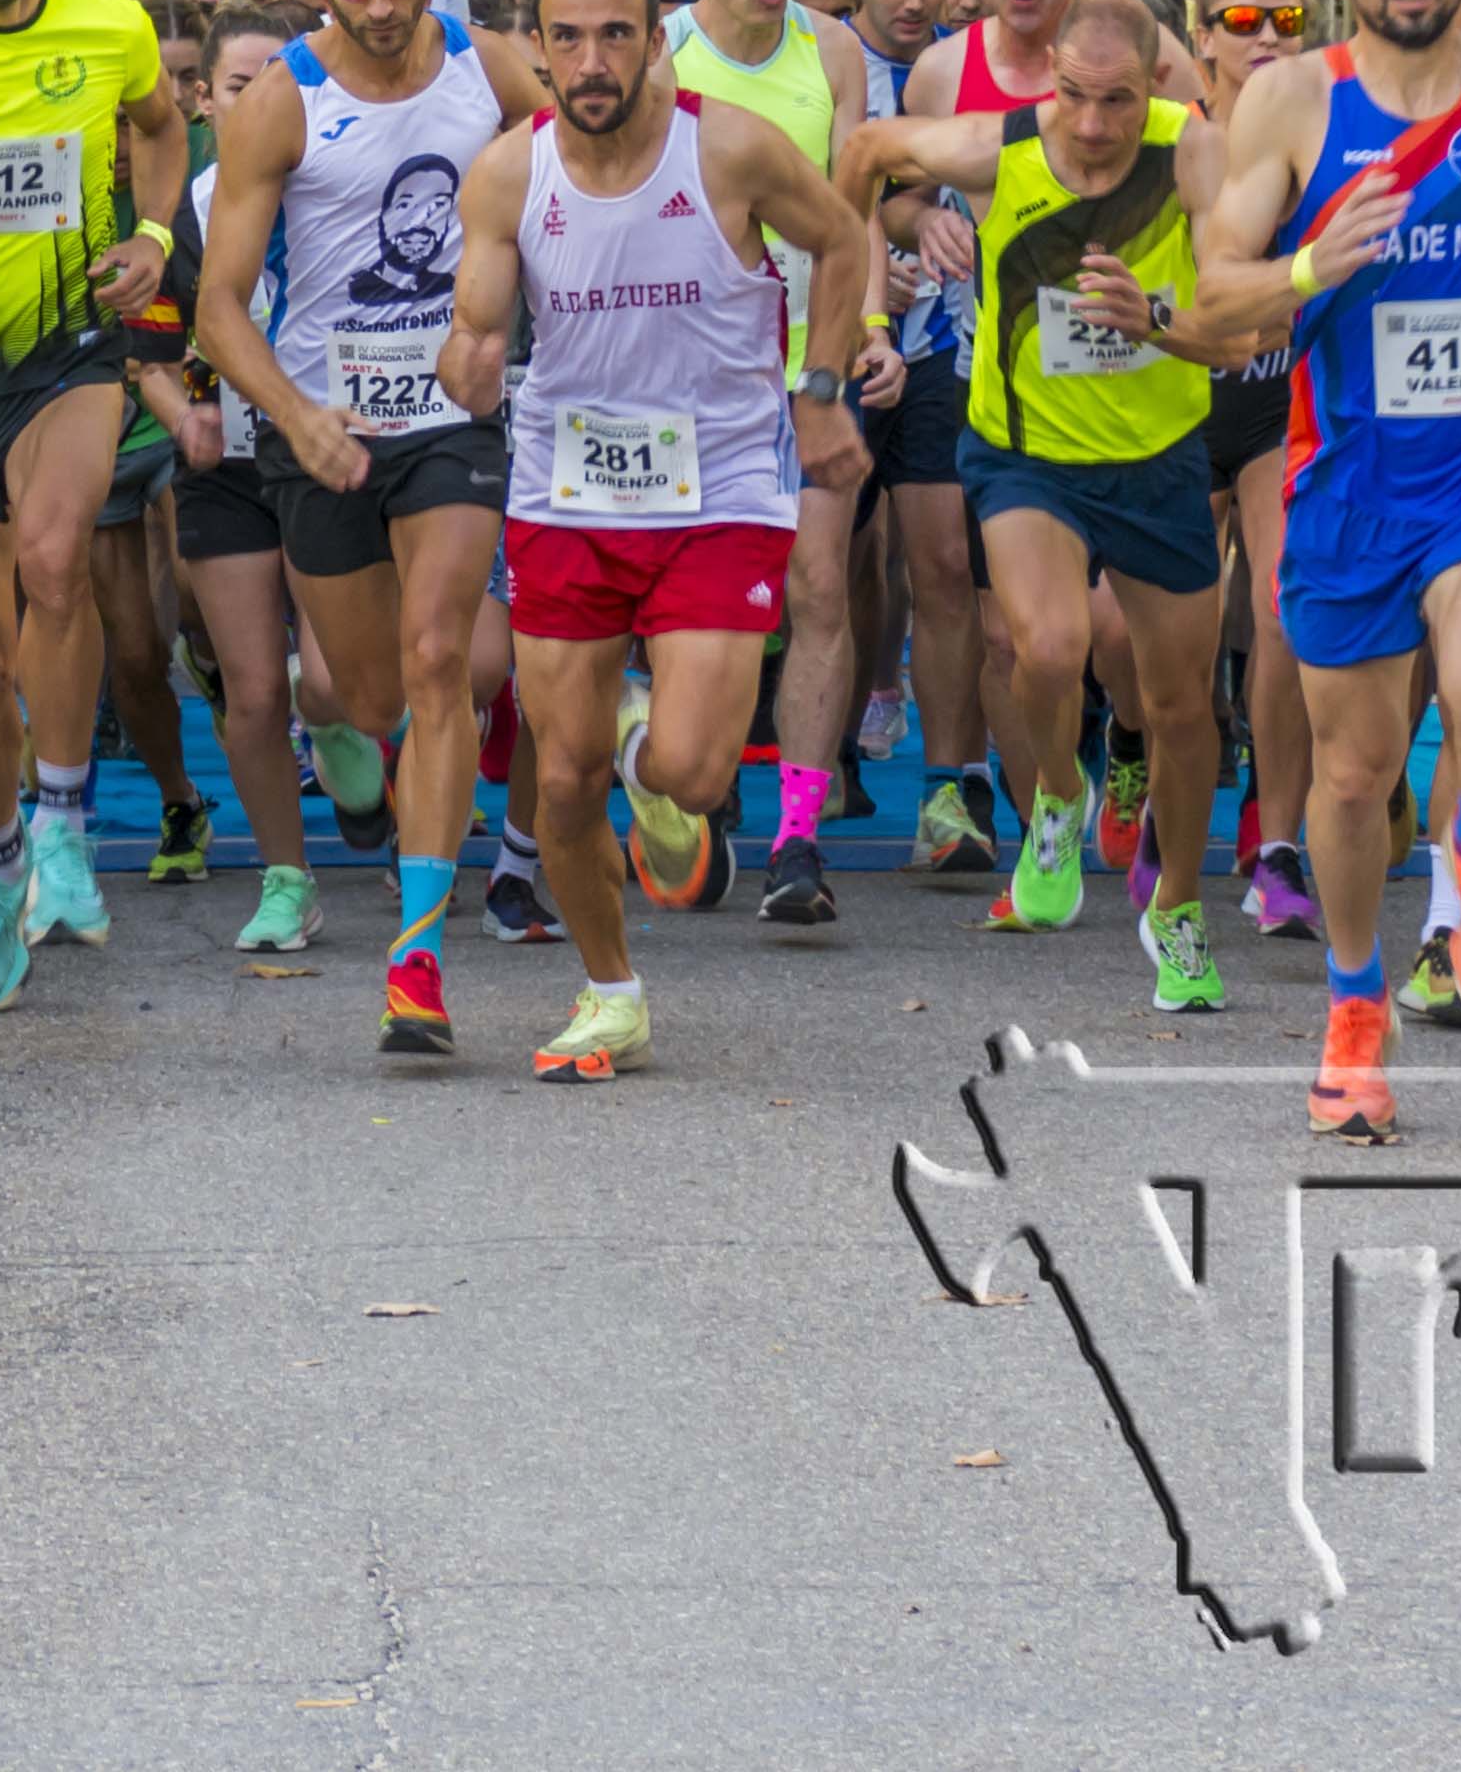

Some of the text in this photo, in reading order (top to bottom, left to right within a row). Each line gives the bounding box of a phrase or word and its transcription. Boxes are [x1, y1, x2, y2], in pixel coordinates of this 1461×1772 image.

[341, 363, 384, 375] MAST A
[343, 372, 438, 406] 1227
[349, 401, 445, 419] FERNANDO
[583, 436, 654, 473] 281
[584, 470, 669, 490] LORENZO
